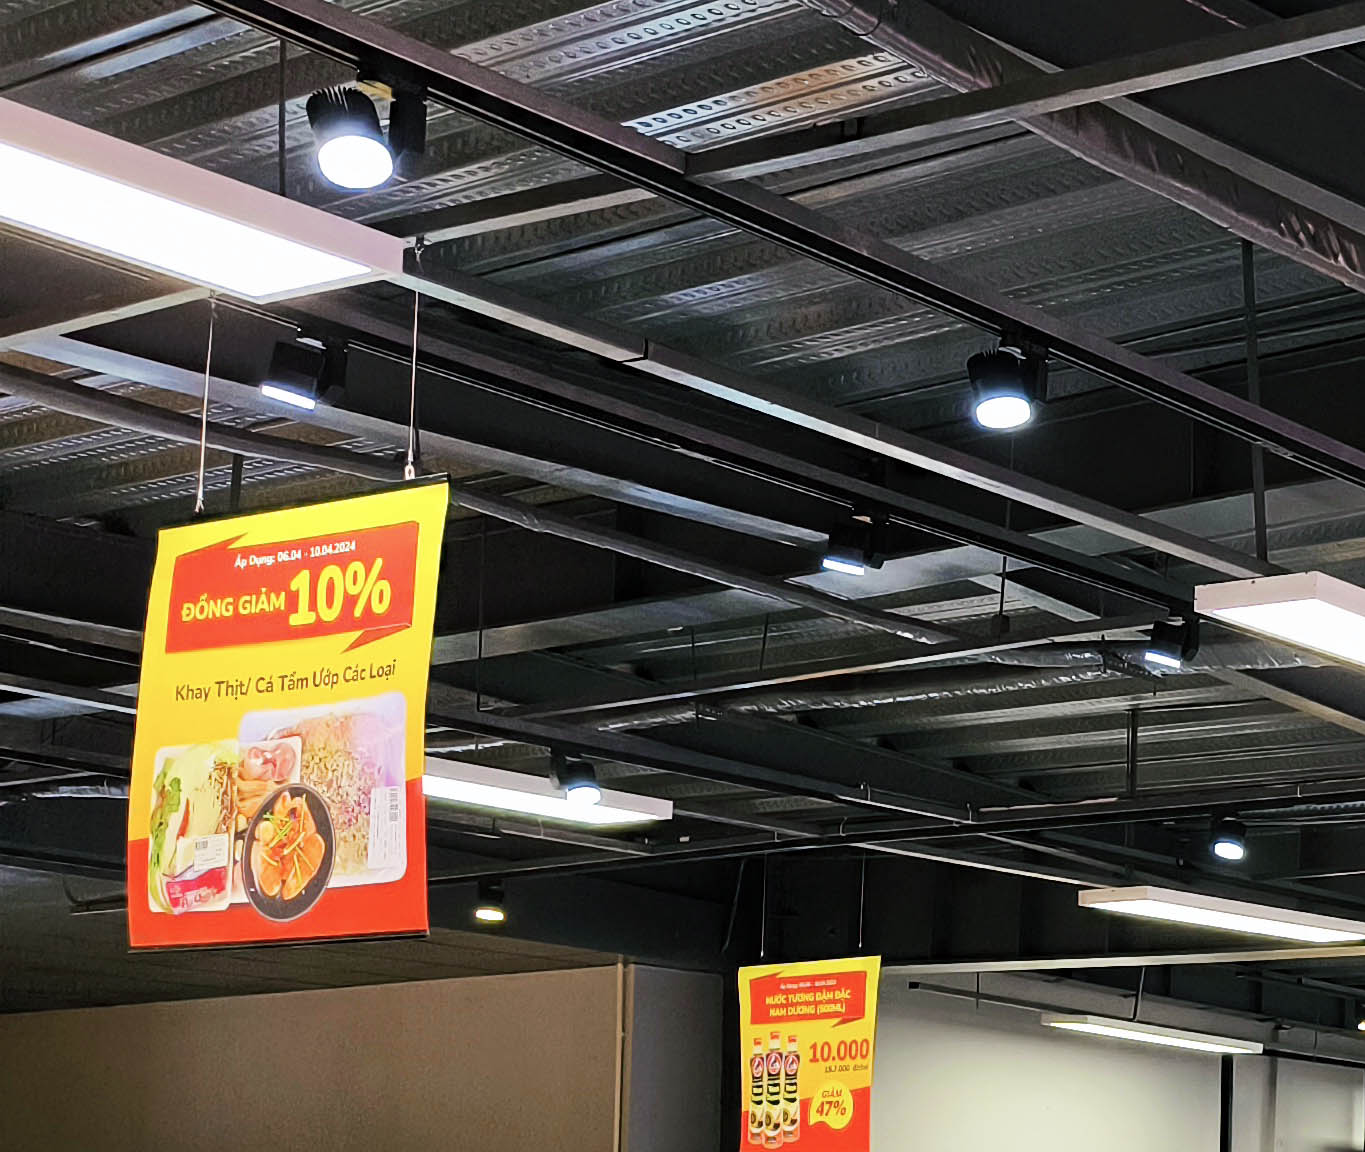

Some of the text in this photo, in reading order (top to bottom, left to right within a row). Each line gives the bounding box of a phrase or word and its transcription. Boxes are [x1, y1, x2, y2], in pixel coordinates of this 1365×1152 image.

[235, 555, 247, 569] Áp
[277, 550, 302, 562] 06.04
[238, 588, 286, 614] GIẢM
[288, 558, 391, 626] 10%
[175, 684, 211, 702] Khay
[214, 678, 252, 700] Thịt/
[255, 675, 275, 693] Cá
[343, 665, 366, 683] Các
[369, 659, 396, 681] Loại
[808, 1038, 870, 1063] 10.000
[815, 1101, 847, 1117] 47%
